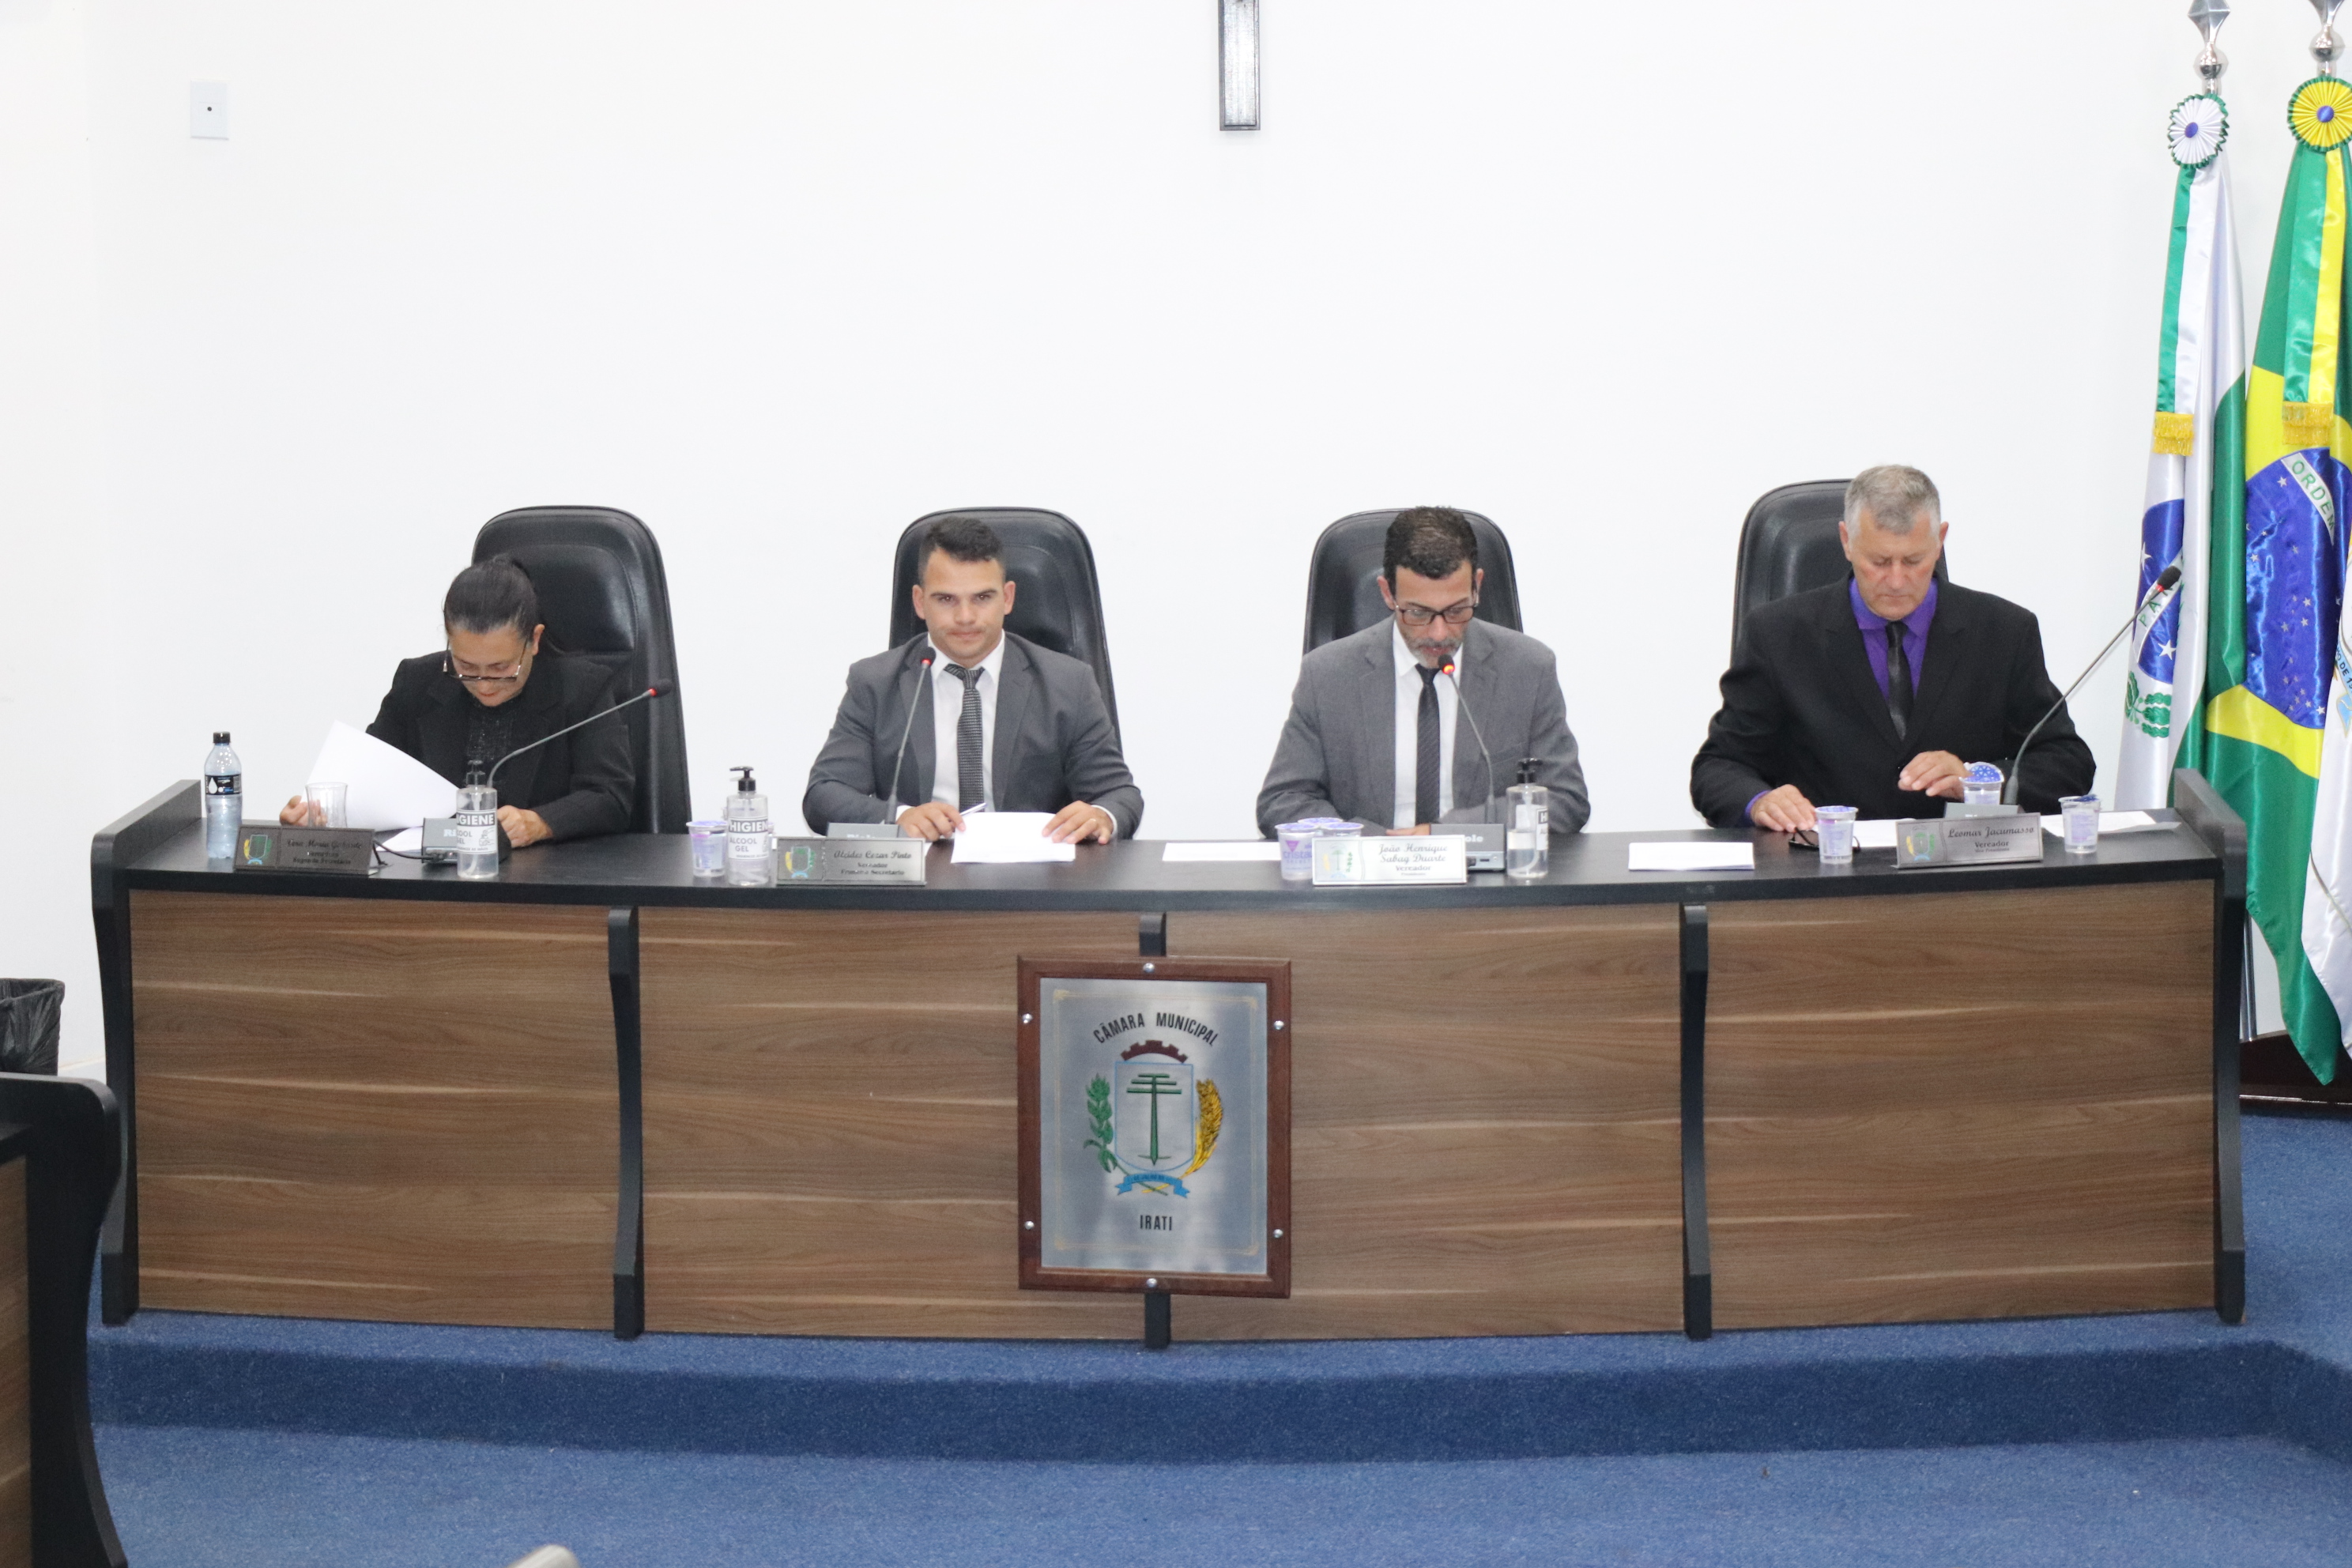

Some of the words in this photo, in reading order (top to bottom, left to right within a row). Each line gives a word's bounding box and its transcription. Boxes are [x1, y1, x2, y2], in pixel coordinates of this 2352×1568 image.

[2292, 460, 2335, 530] ORDEM
[2339, 661, 2350, 677] DE
[1947, 828, 1982, 838] Leomar
[1984, 826, 2034, 838] Jacumasso
[834, 850, 862, 859] Alcides
[865, 850, 888, 859] Cezar
[891, 850, 911, 859] Pinto
[1379, 843, 1400, 854] João
[1404, 842, 1448, 854] Henrique
[1413, 853, 1446, 862] Duarte
[1093, 1012, 1145, 1043] CÂMARA
[1156, 1012, 1219, 1046] MUNICIPAL
[1140, 1215, 1173, 1231] IRATI
